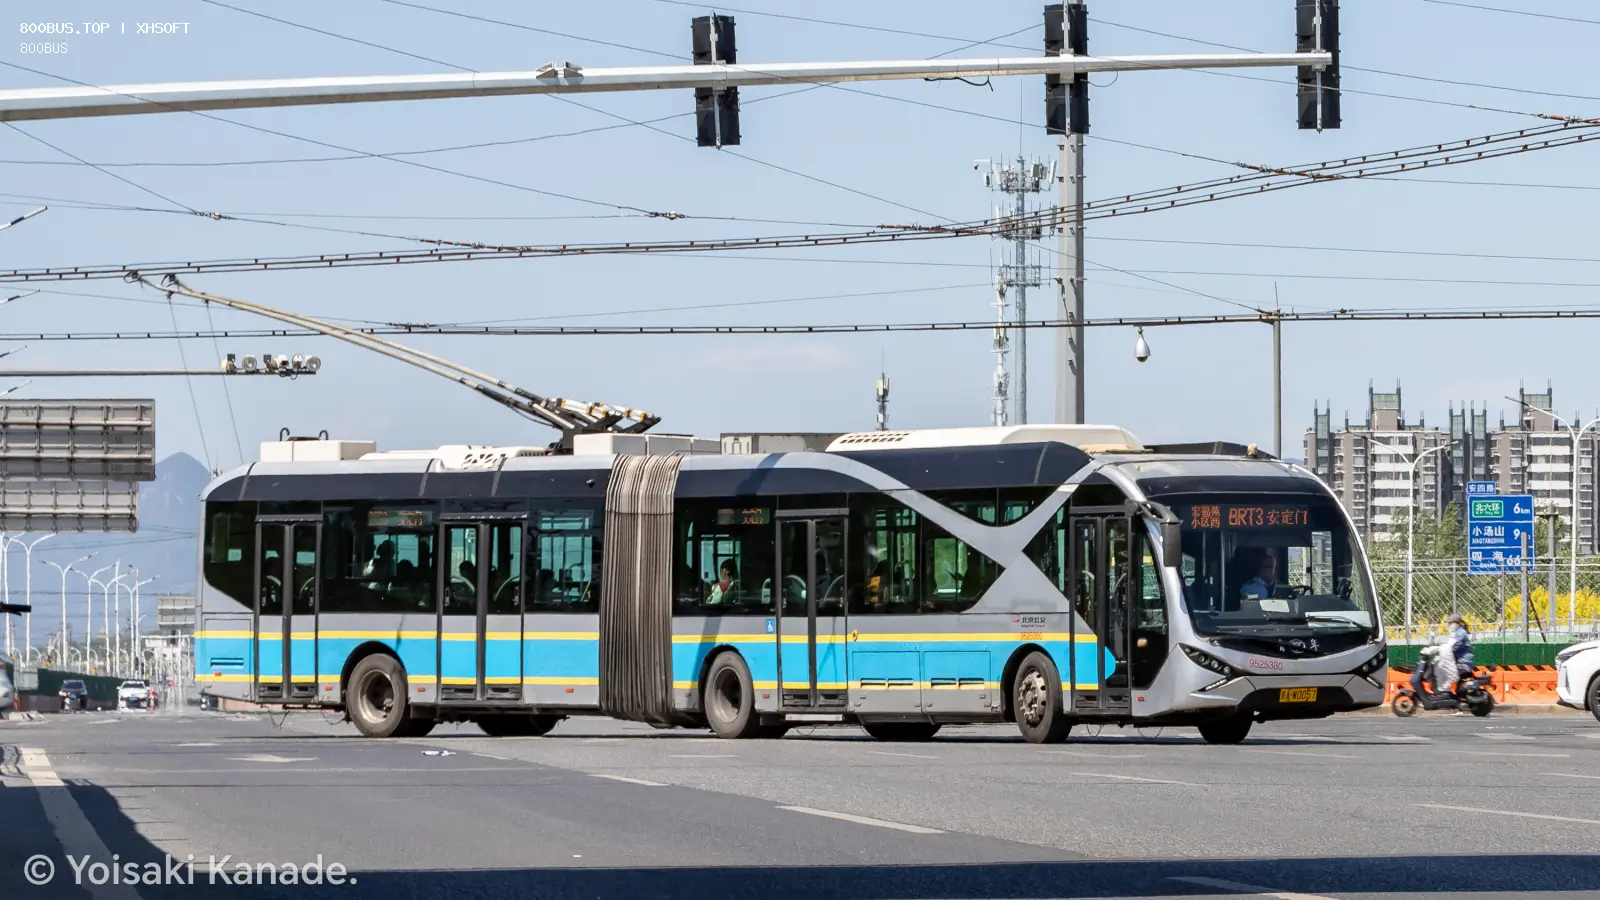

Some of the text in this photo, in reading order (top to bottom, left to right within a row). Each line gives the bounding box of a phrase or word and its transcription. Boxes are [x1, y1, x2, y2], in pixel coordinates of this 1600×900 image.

[1475, 503, 1500, 511] 北六环
[1228, 507, 1308, 526] BRT3 安定门
[1472, 525, 1505, 537] 小汤山
[1249, 658, 1284, 671] 9525380
